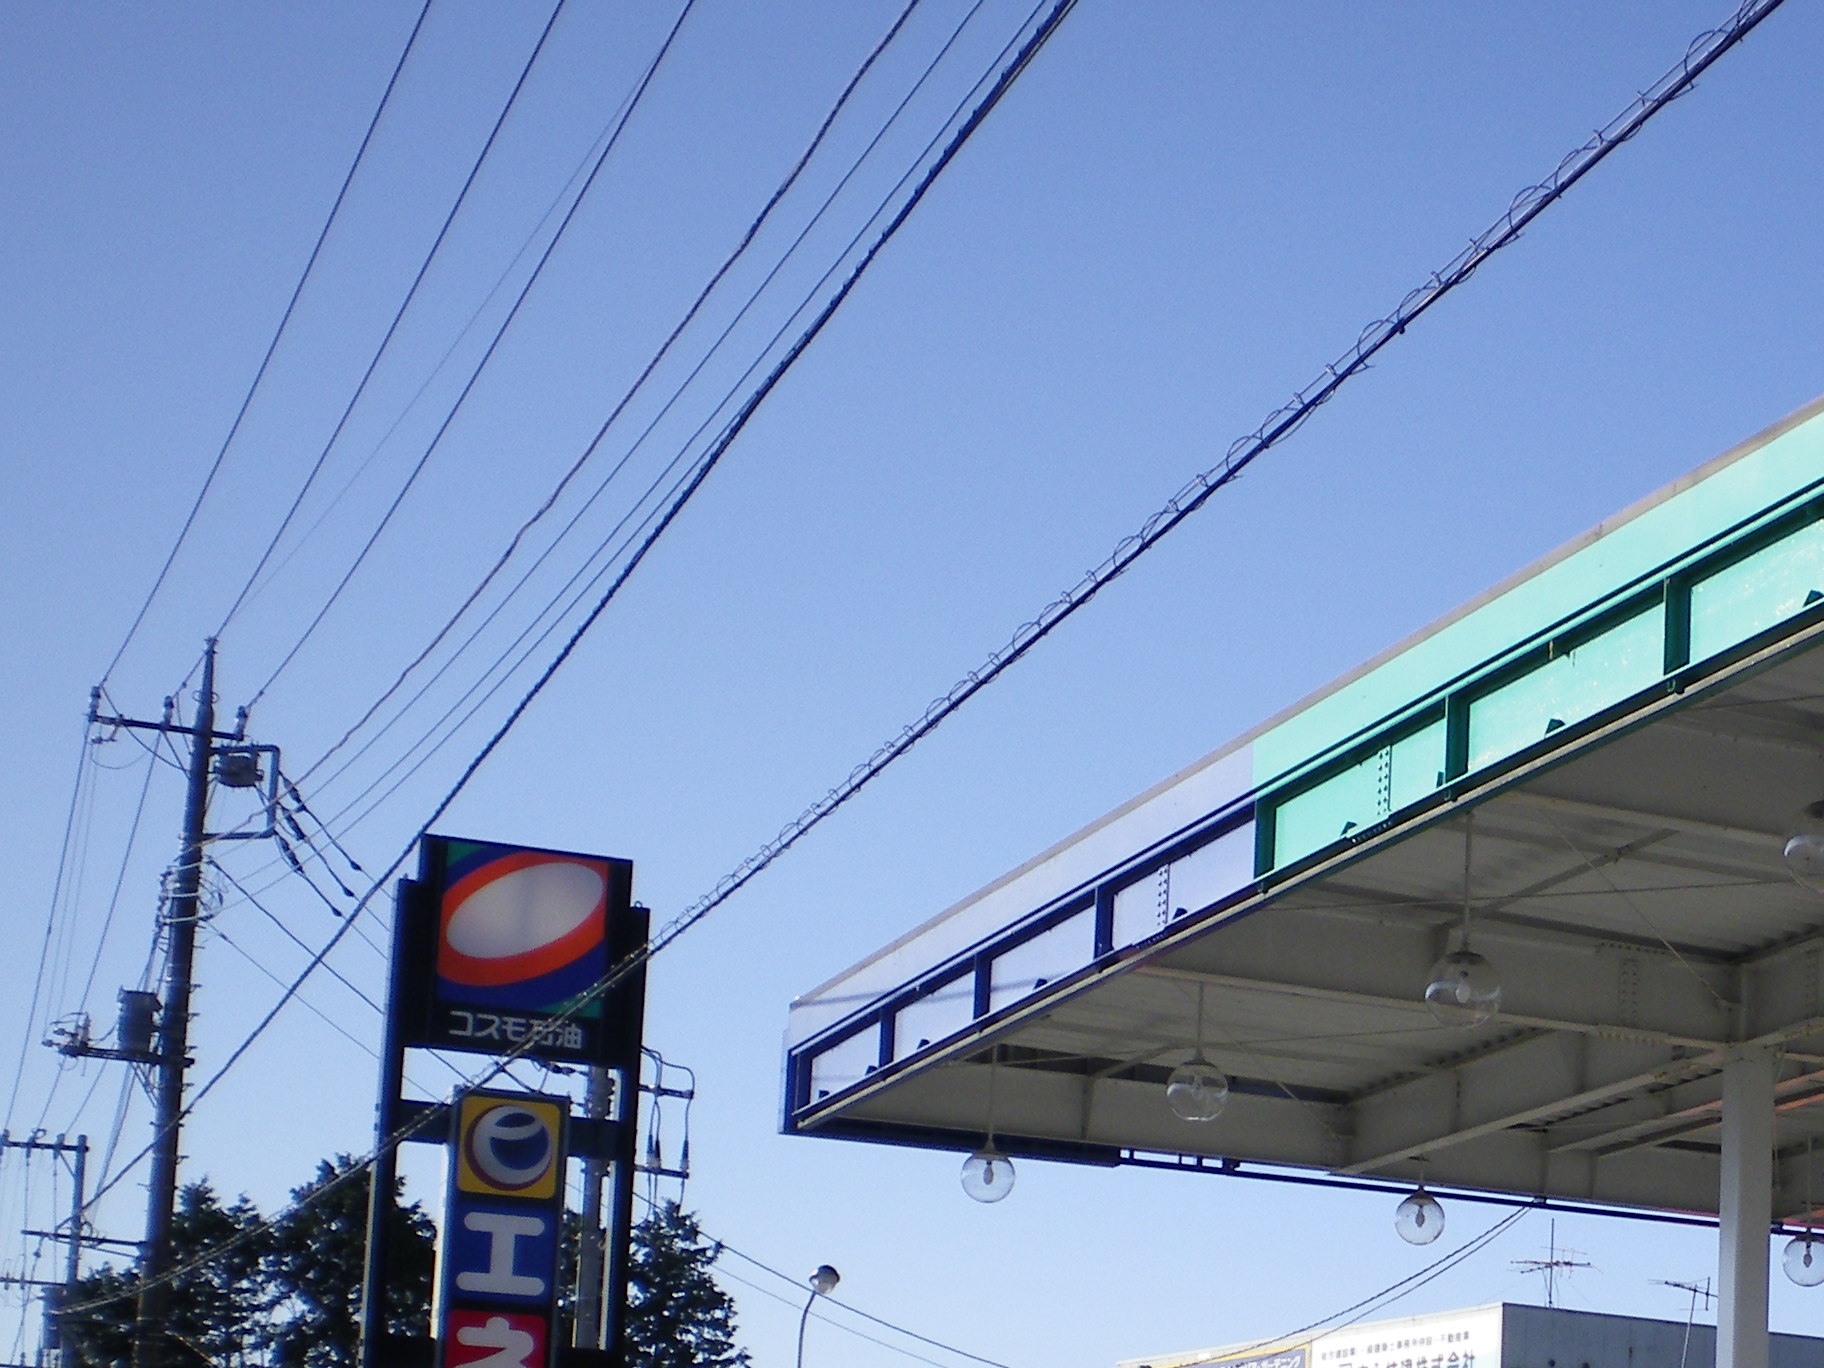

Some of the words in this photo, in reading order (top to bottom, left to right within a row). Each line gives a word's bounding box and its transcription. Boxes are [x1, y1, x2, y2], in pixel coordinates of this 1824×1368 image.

[449, 1010, 583, 1049] コスモ石油
